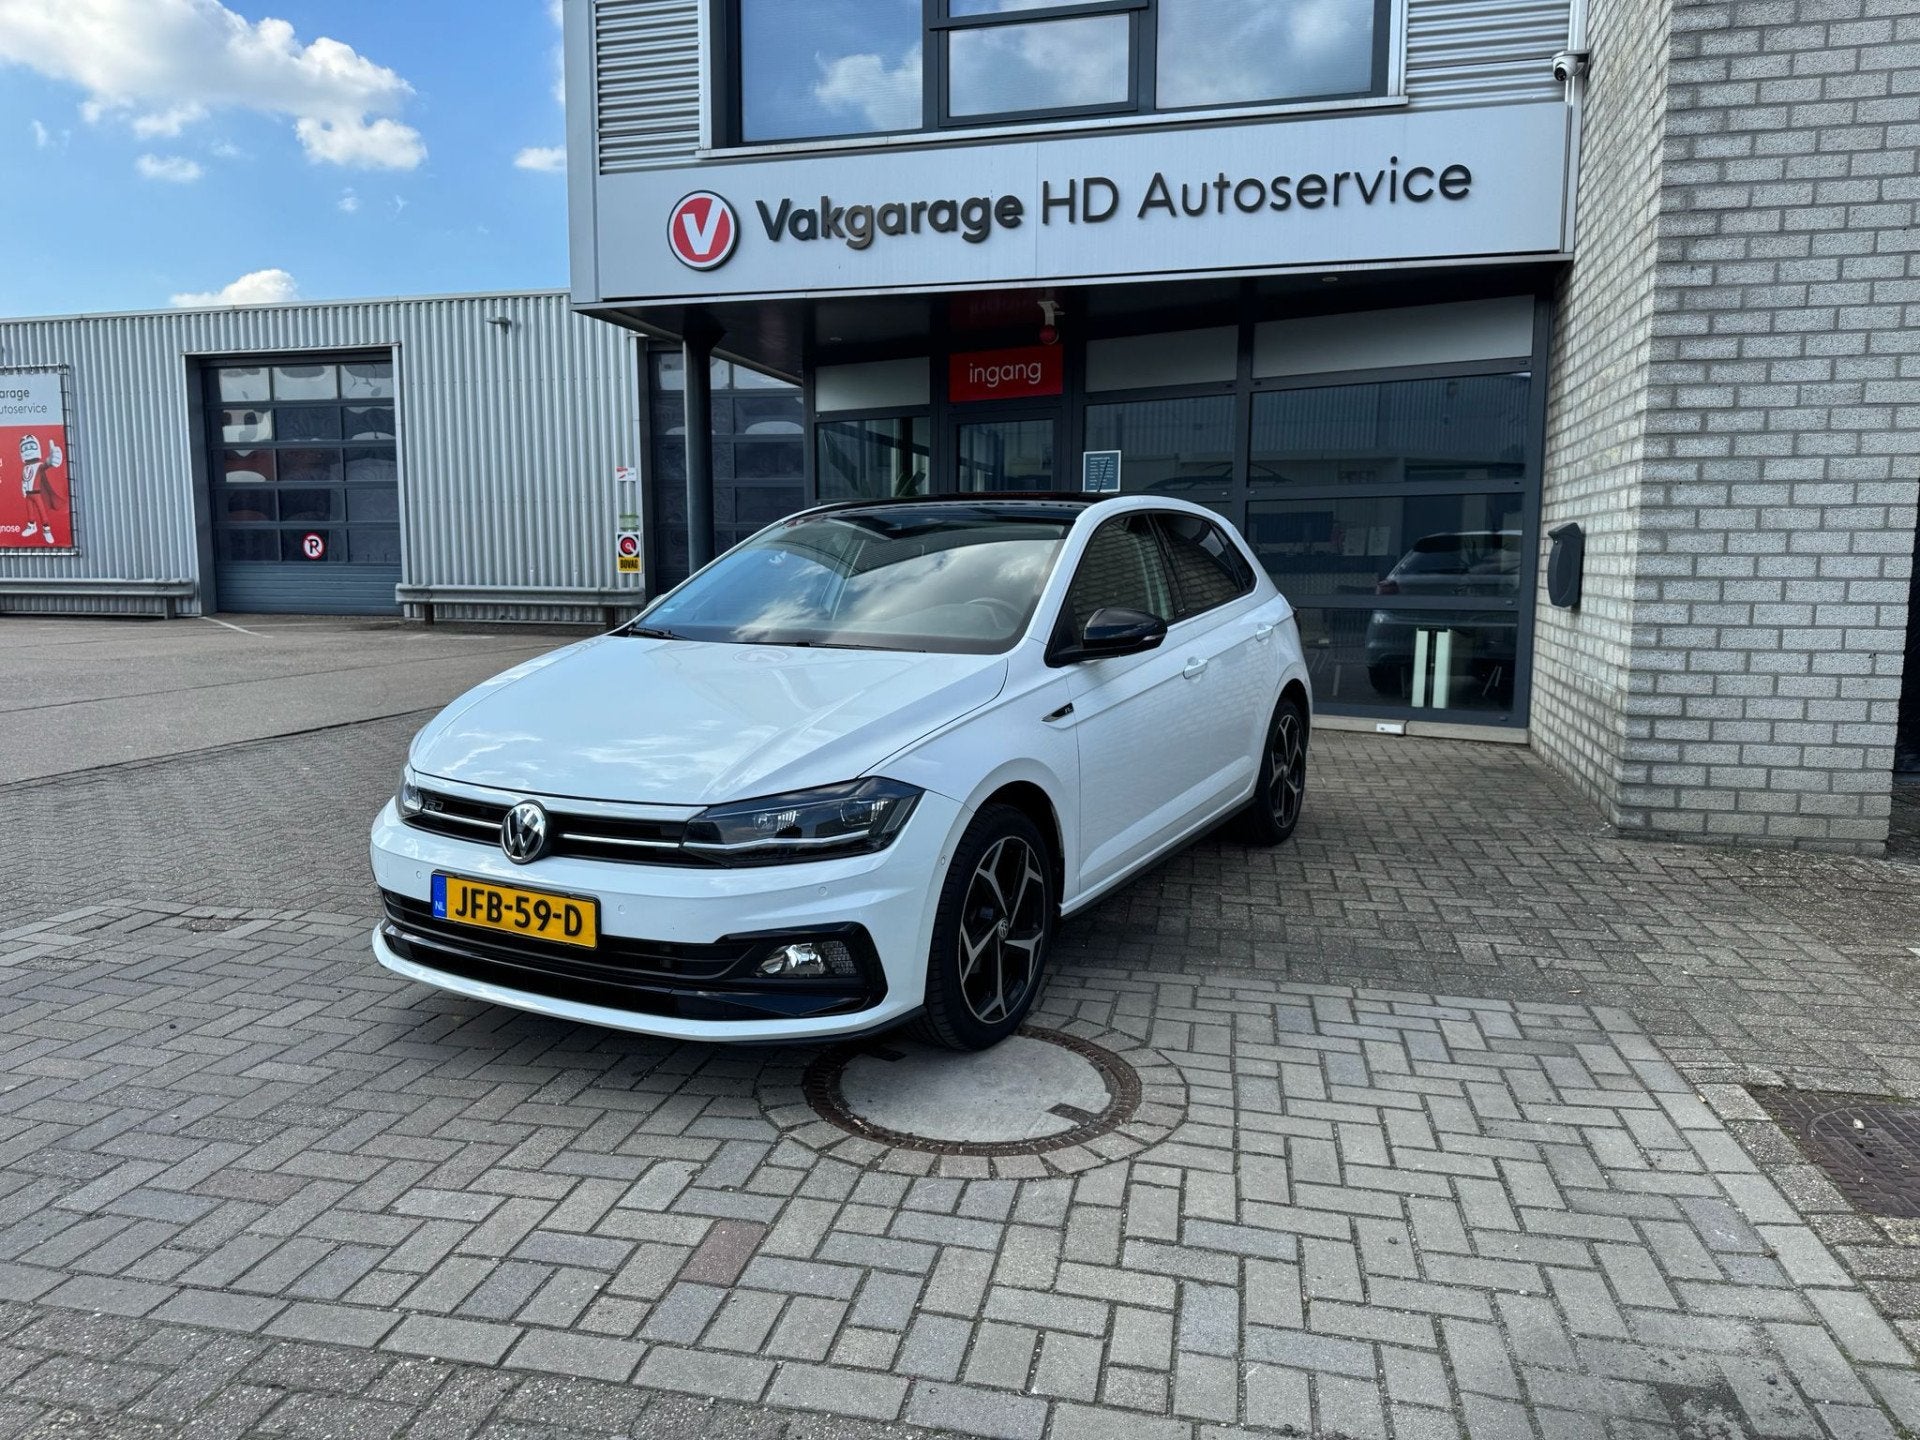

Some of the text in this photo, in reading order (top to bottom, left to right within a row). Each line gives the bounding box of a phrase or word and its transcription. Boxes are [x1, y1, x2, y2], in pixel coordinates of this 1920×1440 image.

[755, 156, 1473, 250] Vakgarage HD Autoservice
[969, 361, 1042, 388] ingang
[433, 900, 446, 912] NL
[455, 886, 583, 938] JFB-59-D
